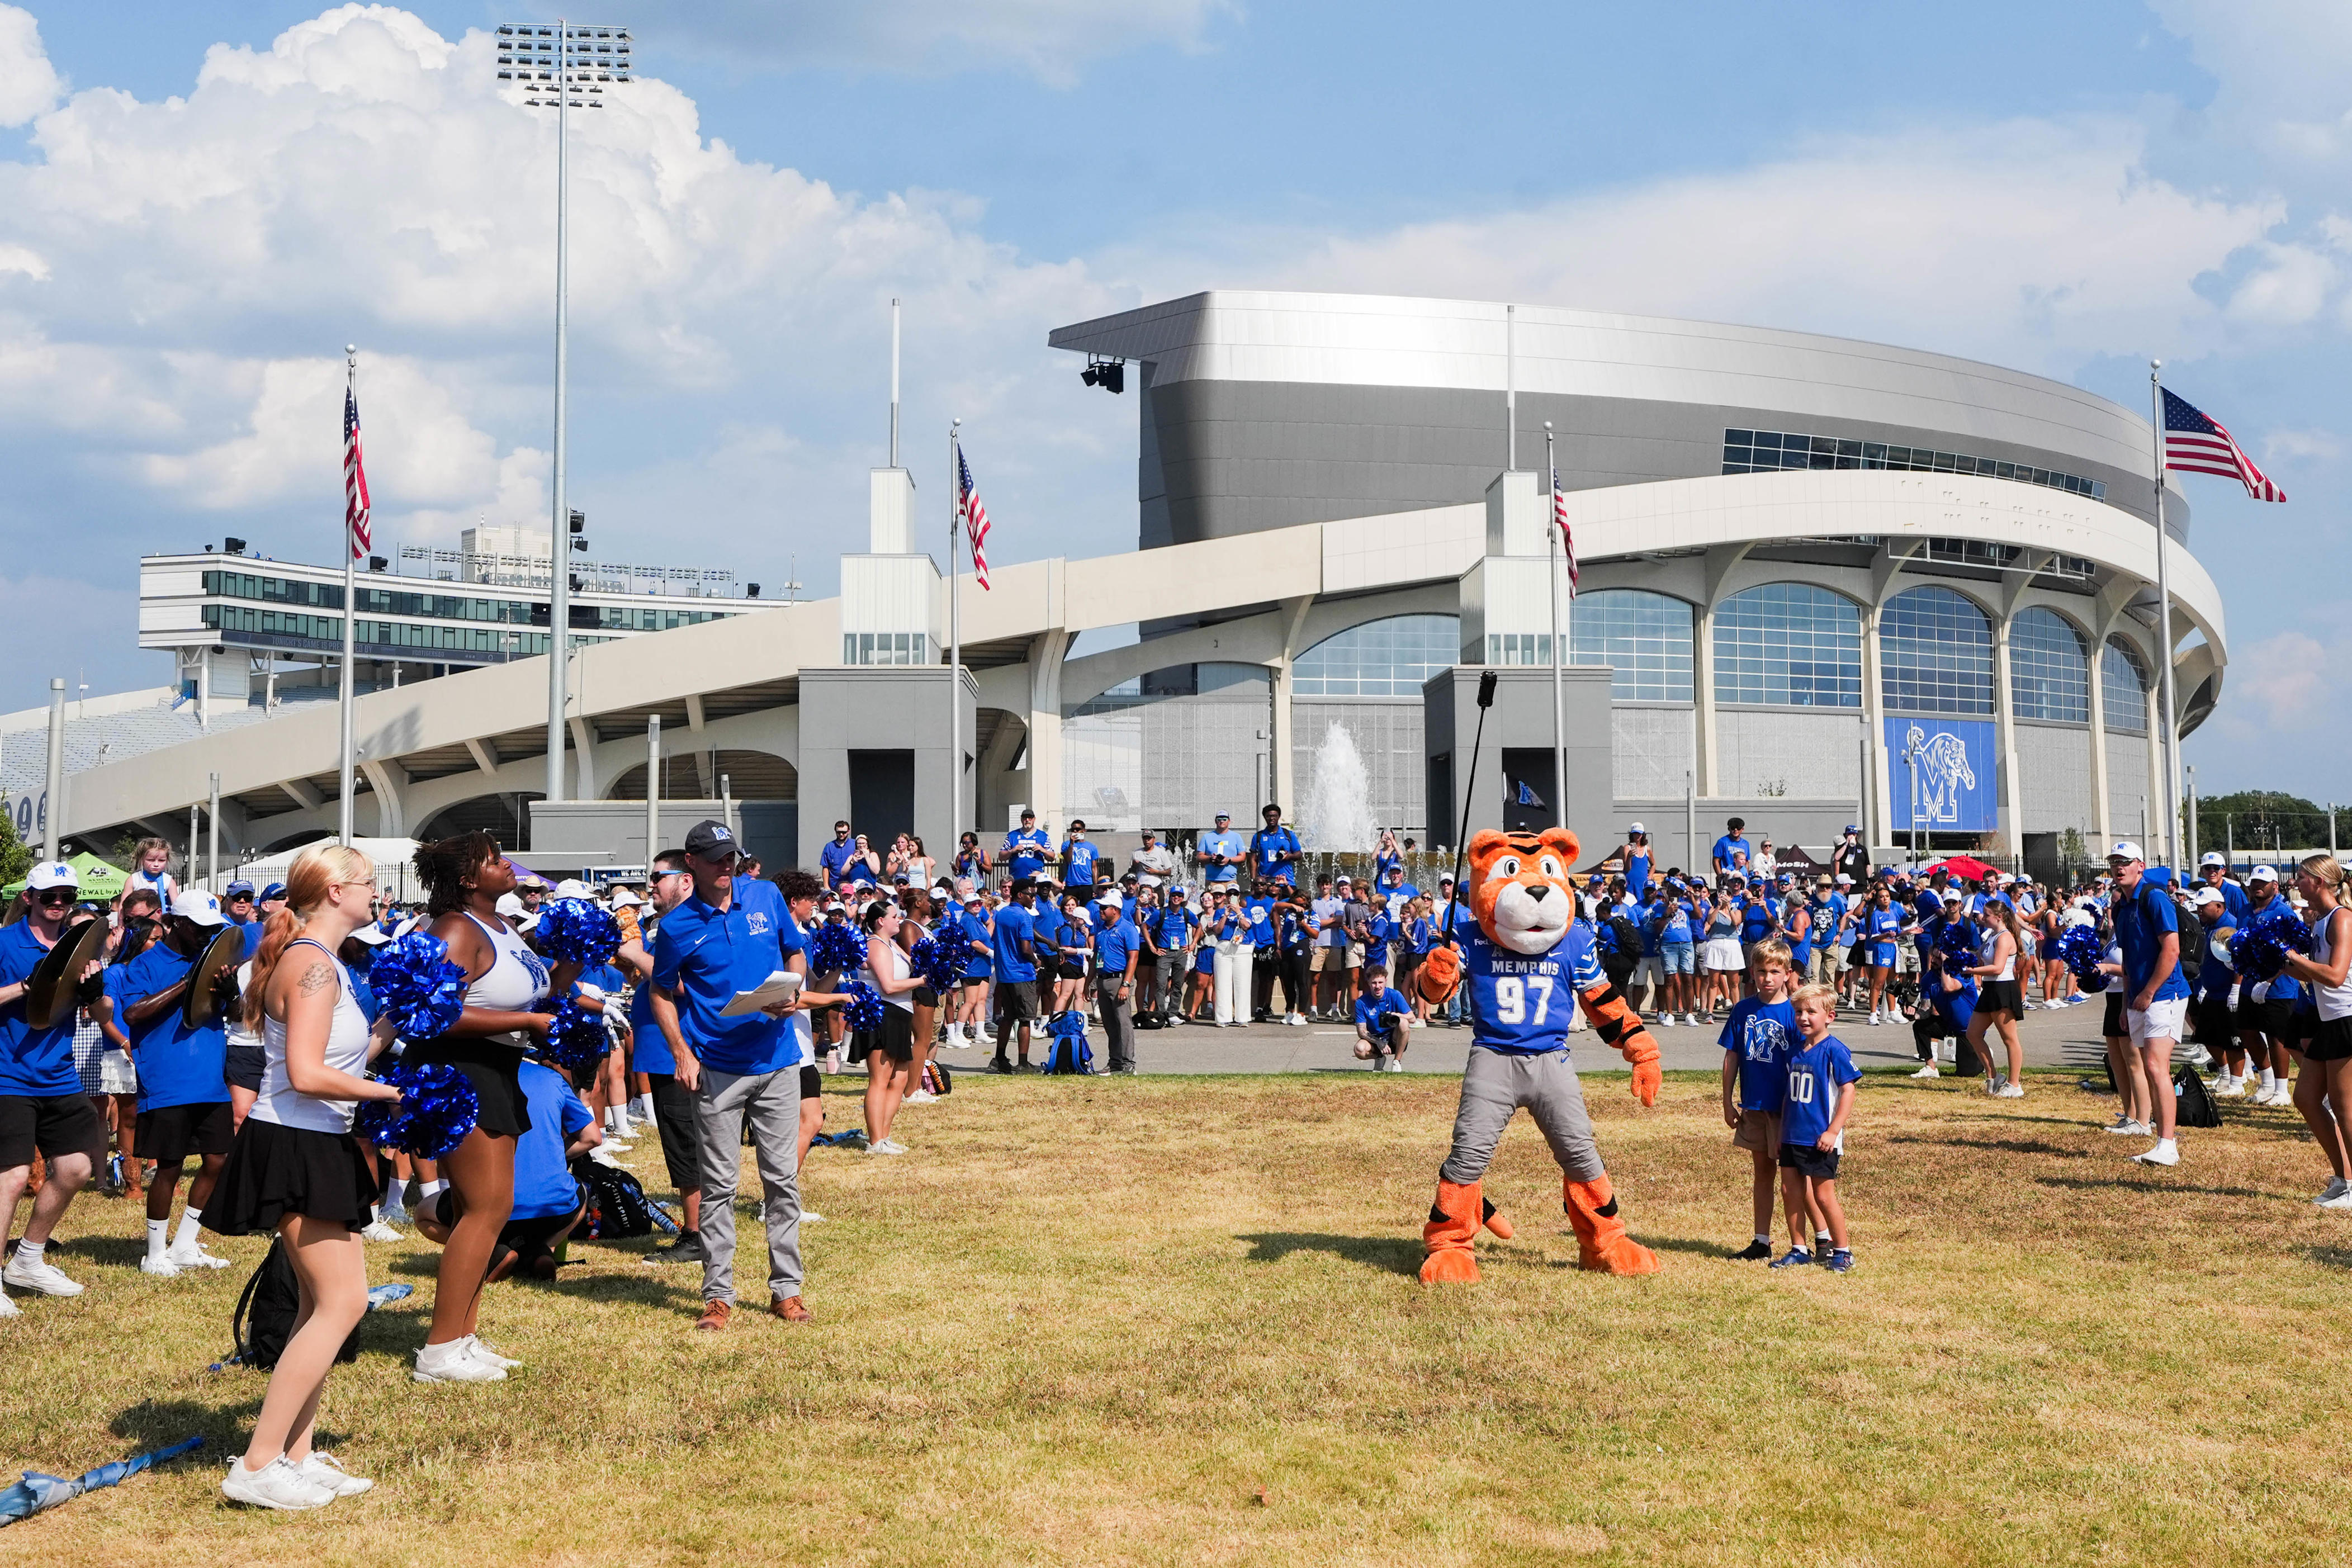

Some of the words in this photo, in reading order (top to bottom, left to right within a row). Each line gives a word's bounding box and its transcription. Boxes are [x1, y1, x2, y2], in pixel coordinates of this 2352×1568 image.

[272, 637, 301, 647] TONIGHT'S
[303, 639, 320, 649] GAME
[321, 641, 327, 650] IS
[329, 642, 363, 652] PRESED
[1492, 960, 1559, 975] MEMPHIS
[1496, 977, 1554, 1026] 97
[1790, 1072, 1814, 1103] 00
[618, 1206, 630, 1228] SPIRIT
